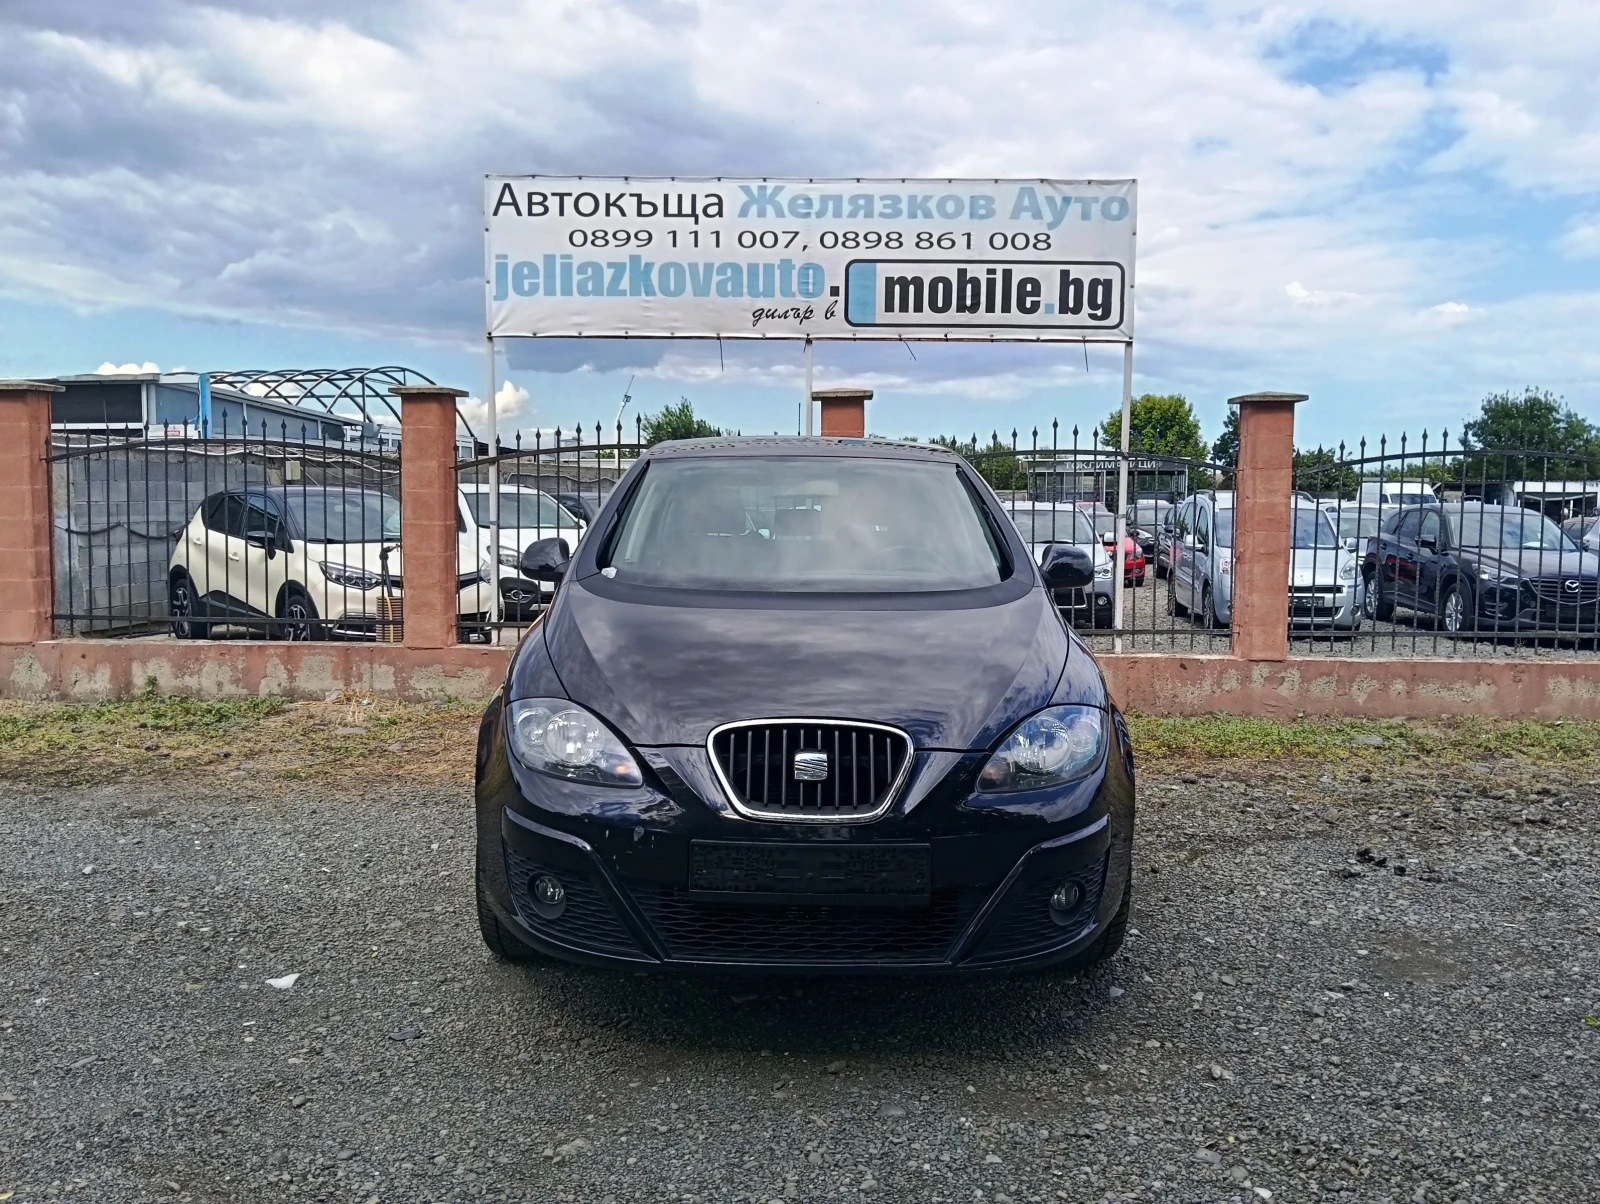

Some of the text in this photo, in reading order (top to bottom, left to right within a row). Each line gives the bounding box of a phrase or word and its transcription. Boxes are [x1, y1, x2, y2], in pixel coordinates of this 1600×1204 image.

[492, 182, 1130, 231] Автокъща Желязков Ауто
[568, 229, 1052, 252] 0899 111 007, 0898 861 008
[884, 268, 1114, 322] mobile.bg
